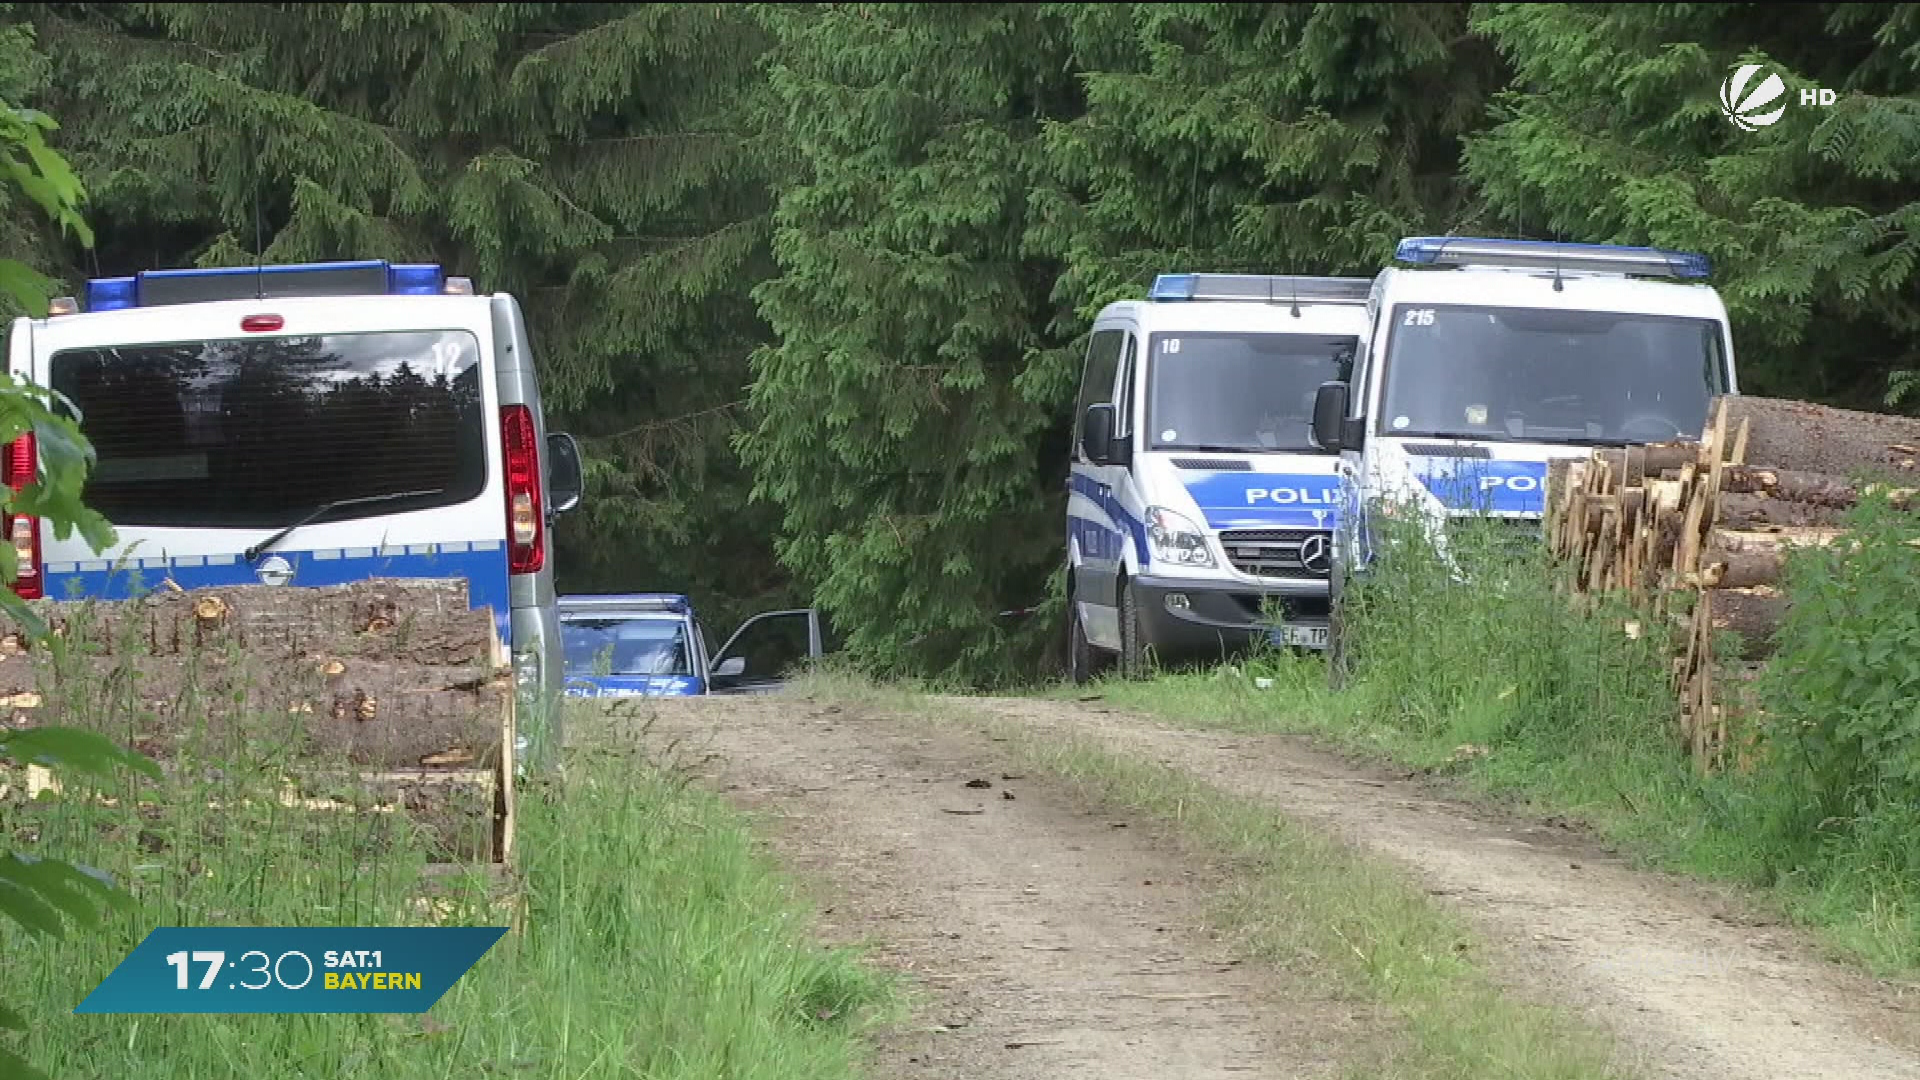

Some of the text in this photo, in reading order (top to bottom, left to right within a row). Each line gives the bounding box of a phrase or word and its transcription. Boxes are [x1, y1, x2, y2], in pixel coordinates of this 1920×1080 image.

[1403, 308, 1435, 326] 215
[1161, 338, 1180, 354] 10
[431, 342, 463, 374] 12
[1480, 475, 1545, 492] PO
